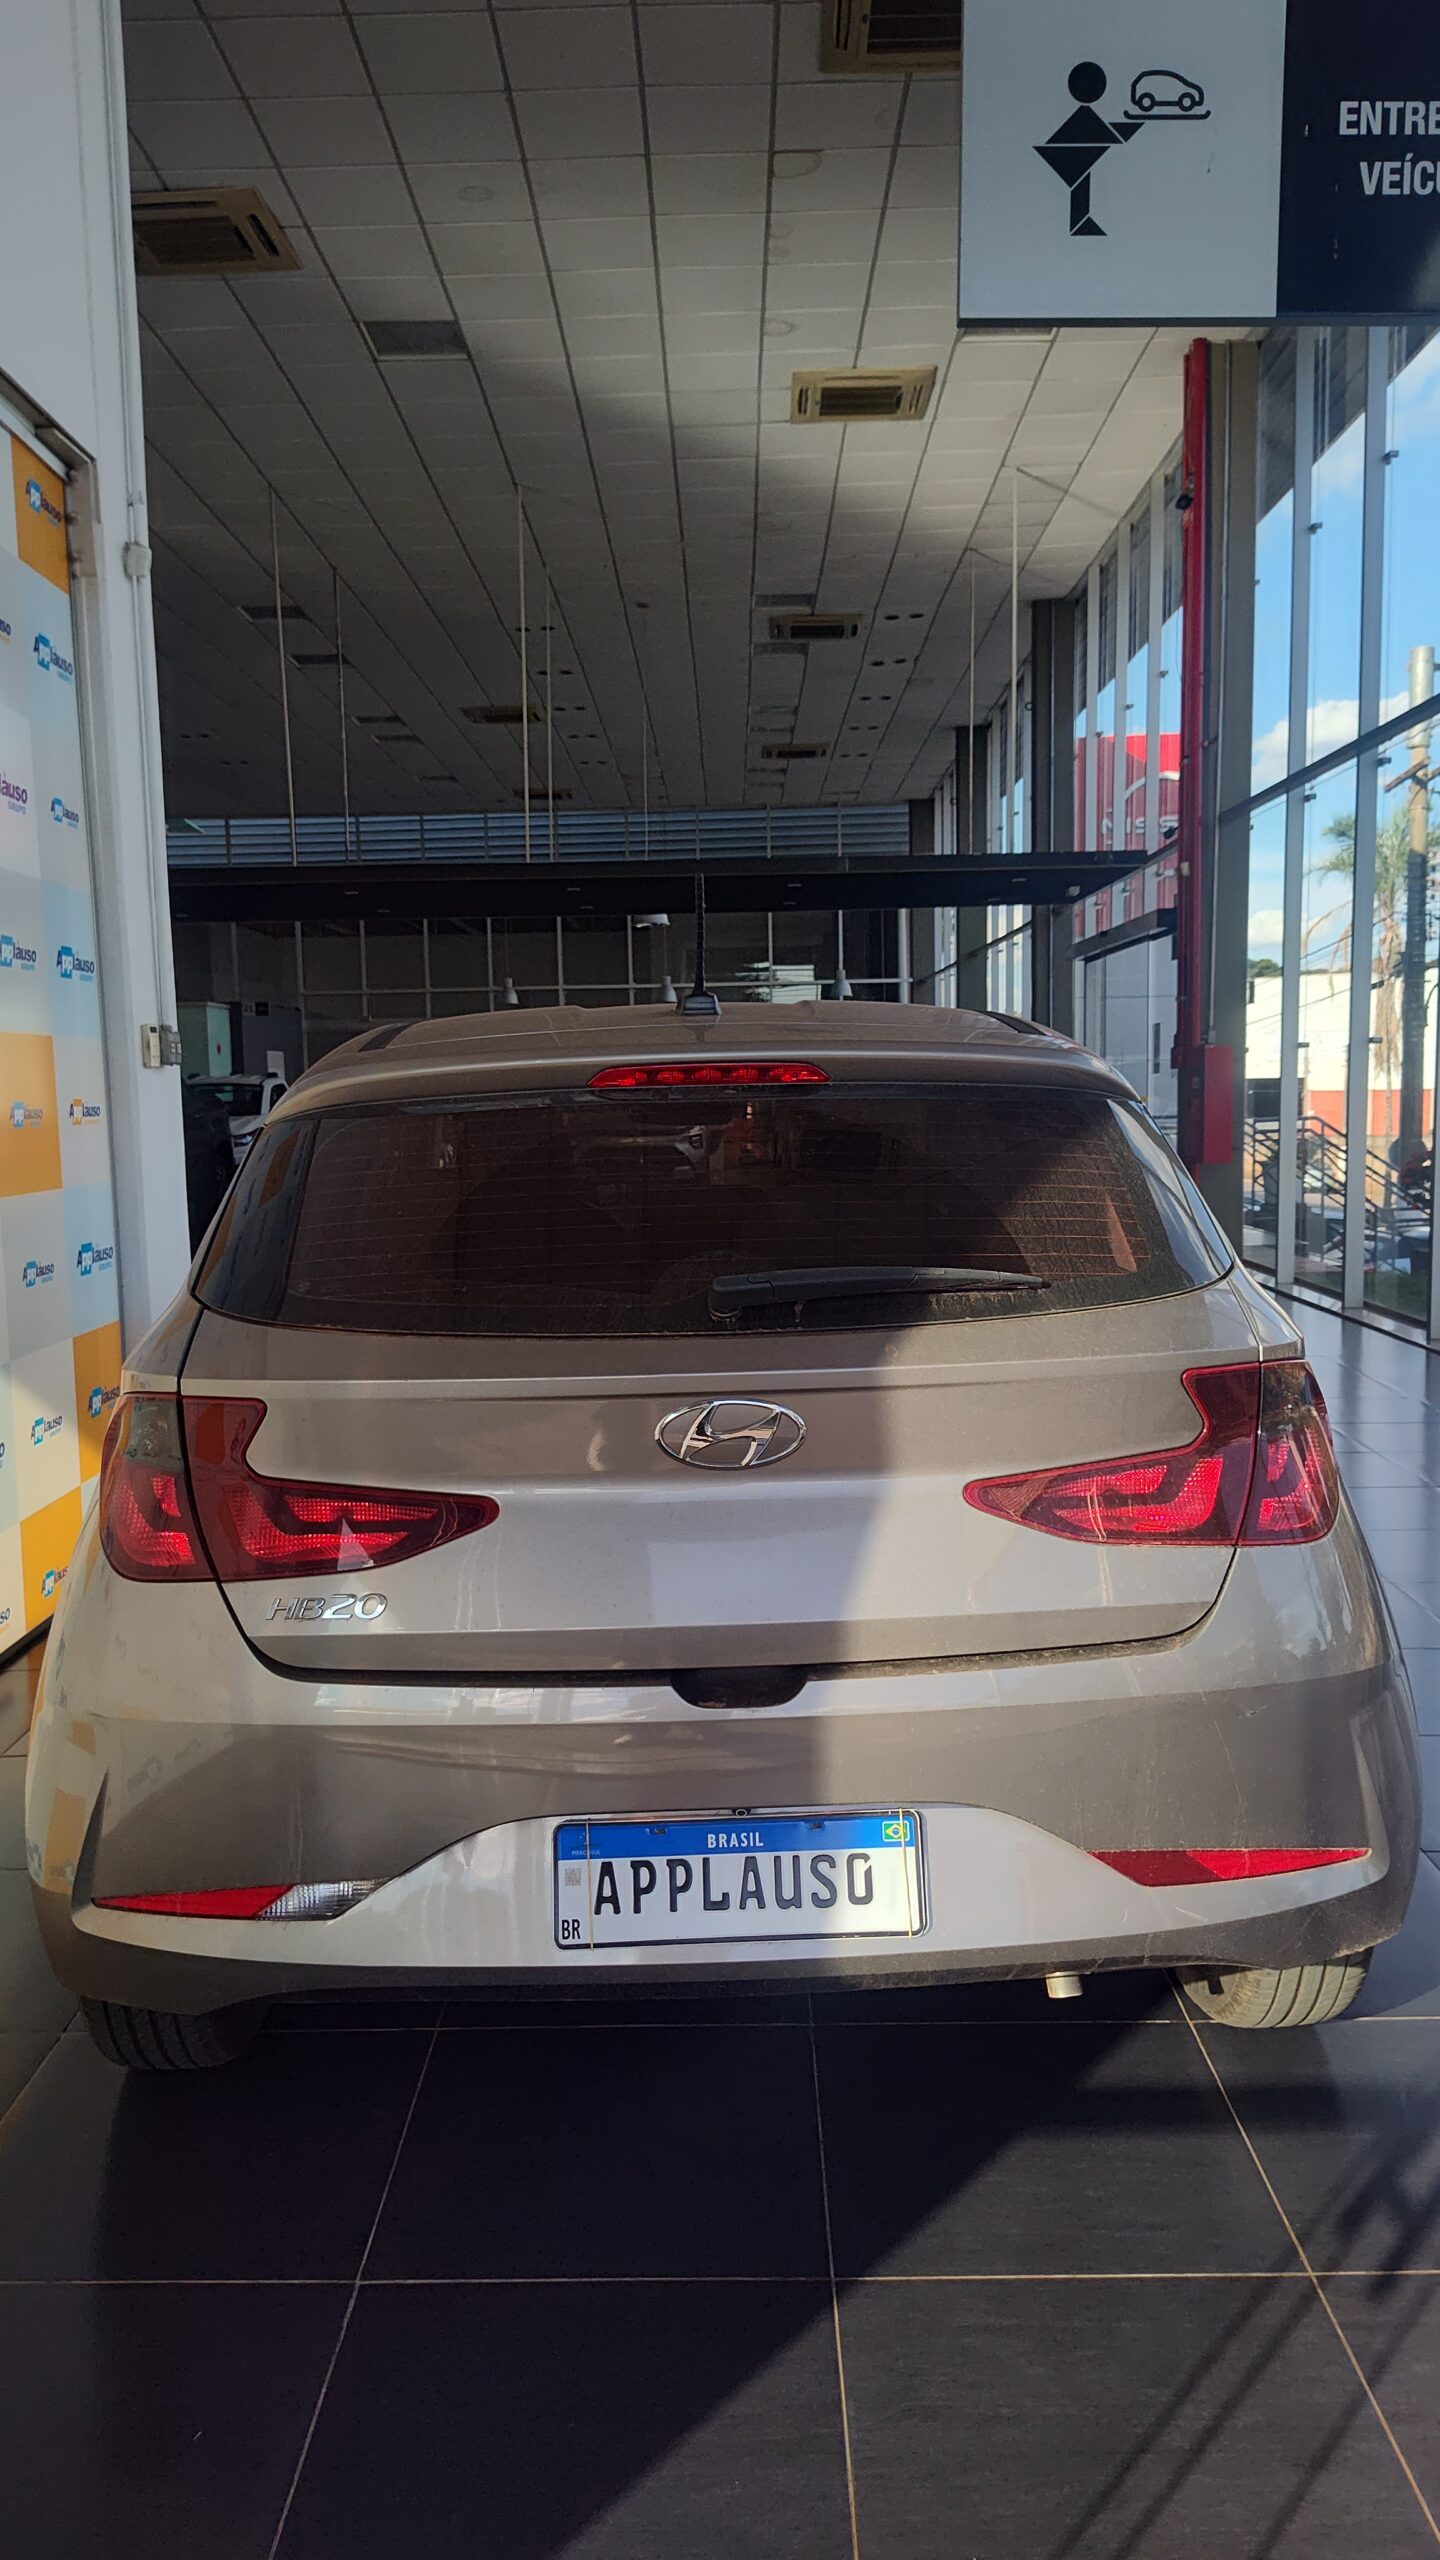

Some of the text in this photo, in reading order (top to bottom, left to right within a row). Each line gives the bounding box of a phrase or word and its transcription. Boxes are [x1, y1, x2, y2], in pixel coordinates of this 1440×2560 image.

[1339, 101, 1440, 135] ENTRE
[1359, 153, 1440, 195] VEÍC
[265, 1593, 388, 1621] HB20
[707, 1832, 763, 1849] BRASIL
[594, 1853, 873, 1915] APPLAUSO
[562, 1919, 580, 1940] BR
